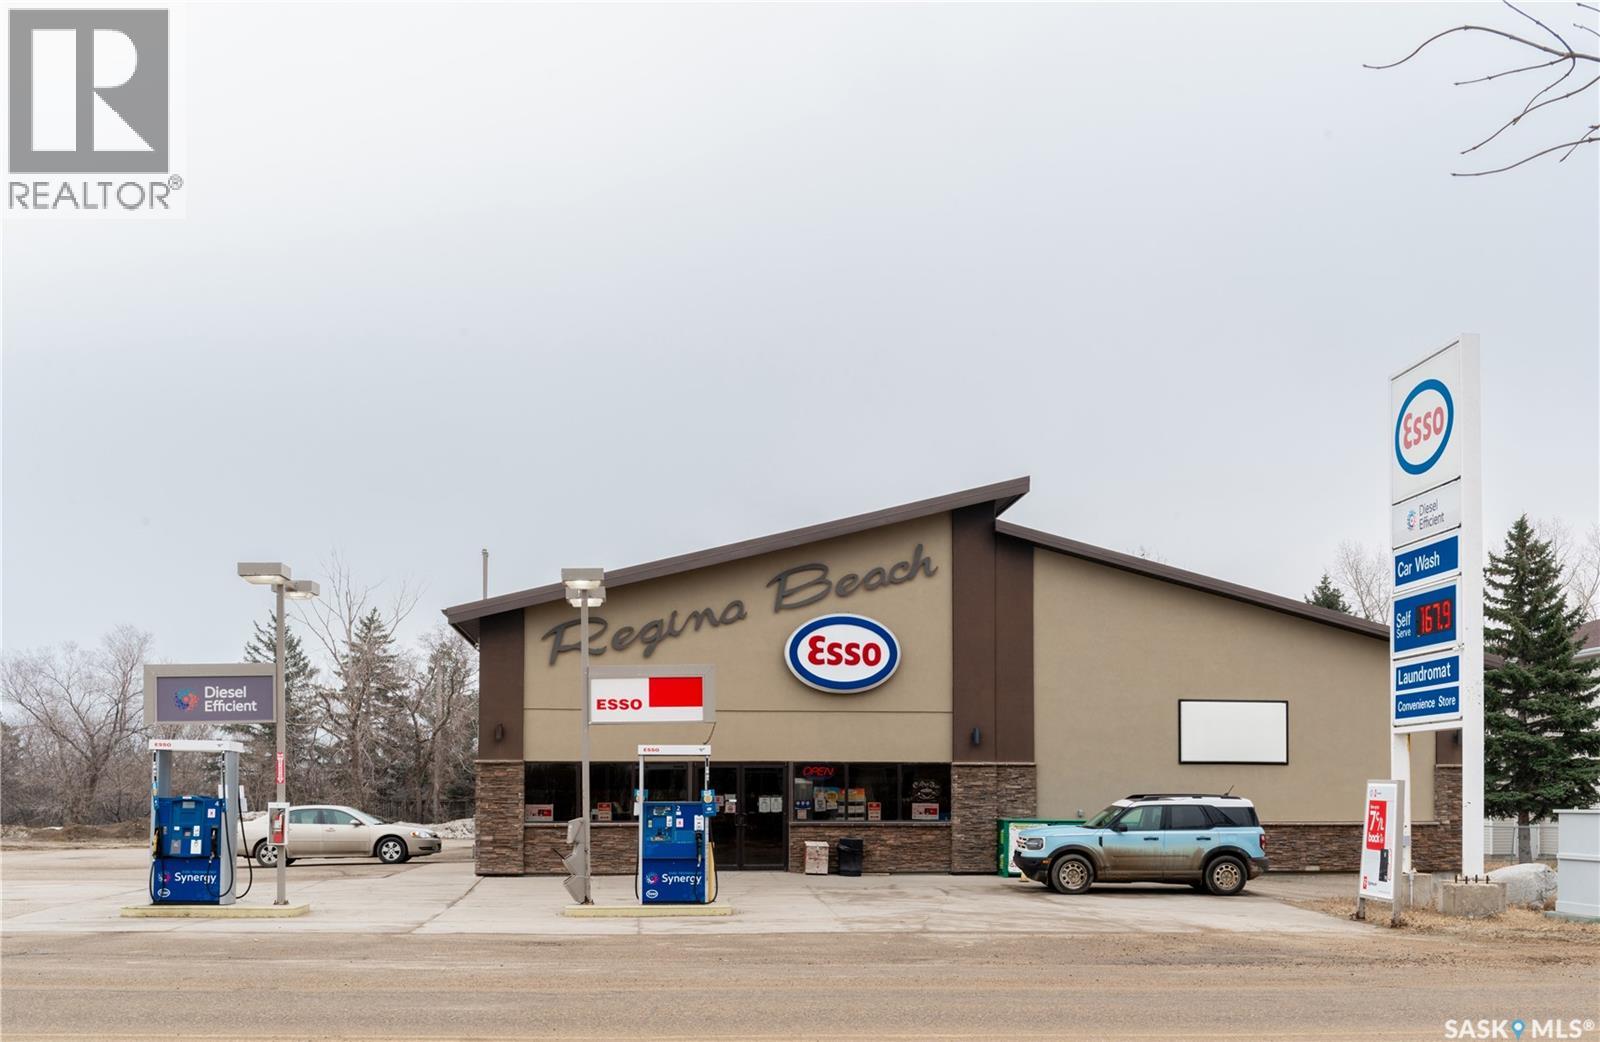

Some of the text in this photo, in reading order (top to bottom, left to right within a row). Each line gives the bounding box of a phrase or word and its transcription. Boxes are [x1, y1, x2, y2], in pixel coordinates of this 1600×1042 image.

[1419, 499, 1438, 516] Diesel
[1419, 512, 1445, 530] Efficient
[1397, 551, 1440, 578] Car Wash
[541, 543, 938, 667] Regina Beach
[1396, 610, 1412, 629] Self
[1396, 628, 1412, 639] Serve
[1398, 663, 1451, 686] Laundromat
[204, 686, 247, 699] Diesel
[204, 699, 257, 713] Efficient
[596, 699, 642, 710] ESSO
[1398, 694, 1456, 712] Convenience Store
[802, 766, 834, 777] OPEN
[174, 872, 217, 885] Synergy
[662, 873, 702, 886] Synergy
